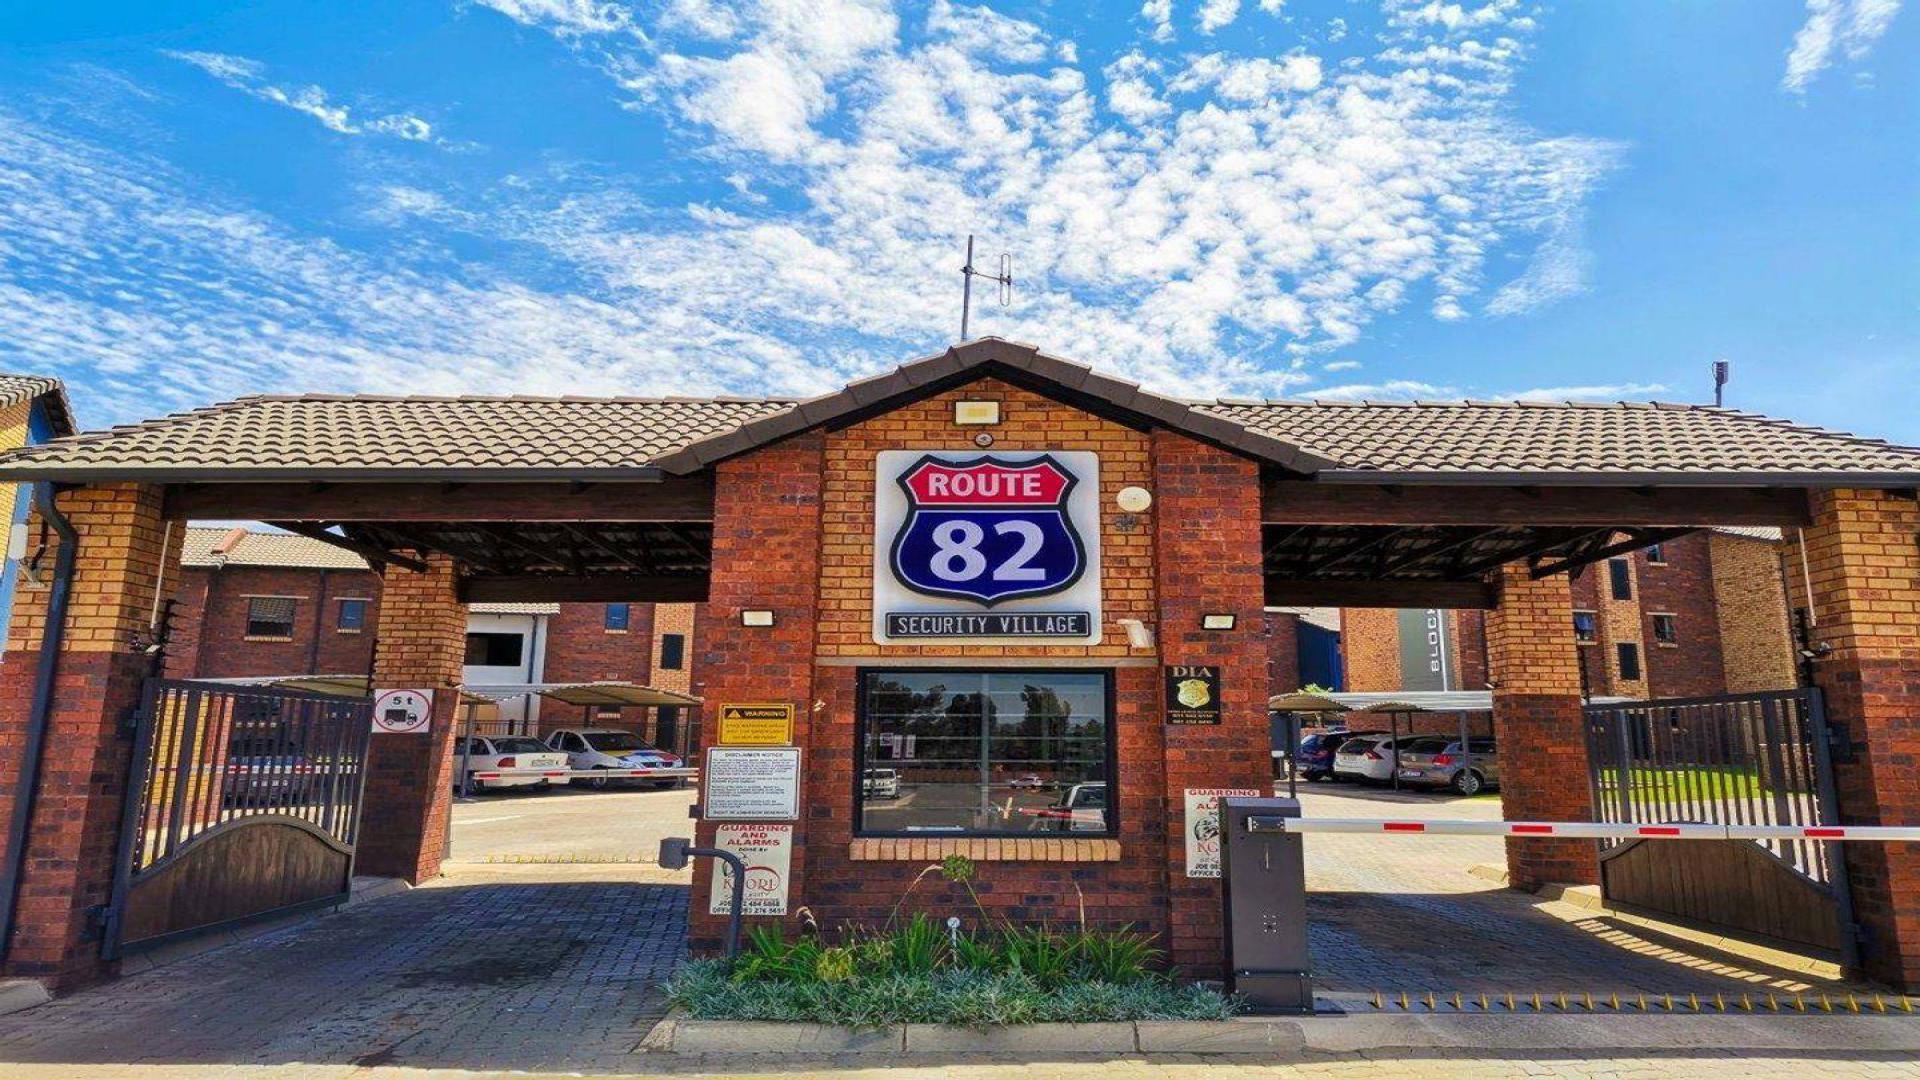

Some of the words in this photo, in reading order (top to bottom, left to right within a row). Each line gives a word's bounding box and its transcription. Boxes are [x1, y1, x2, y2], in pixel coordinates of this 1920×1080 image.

[928, 472, 1042, 497] ROUTE
[929, 519, 1047, 582] 82
[898, 616, 988, 634] SECURITY
[1000, 616, 1078, 633] VILLAGE
[1172, 666, 1212, 678] DIA
[392, 696, 402, 705] 5
[407, 696, 413, 705] t
